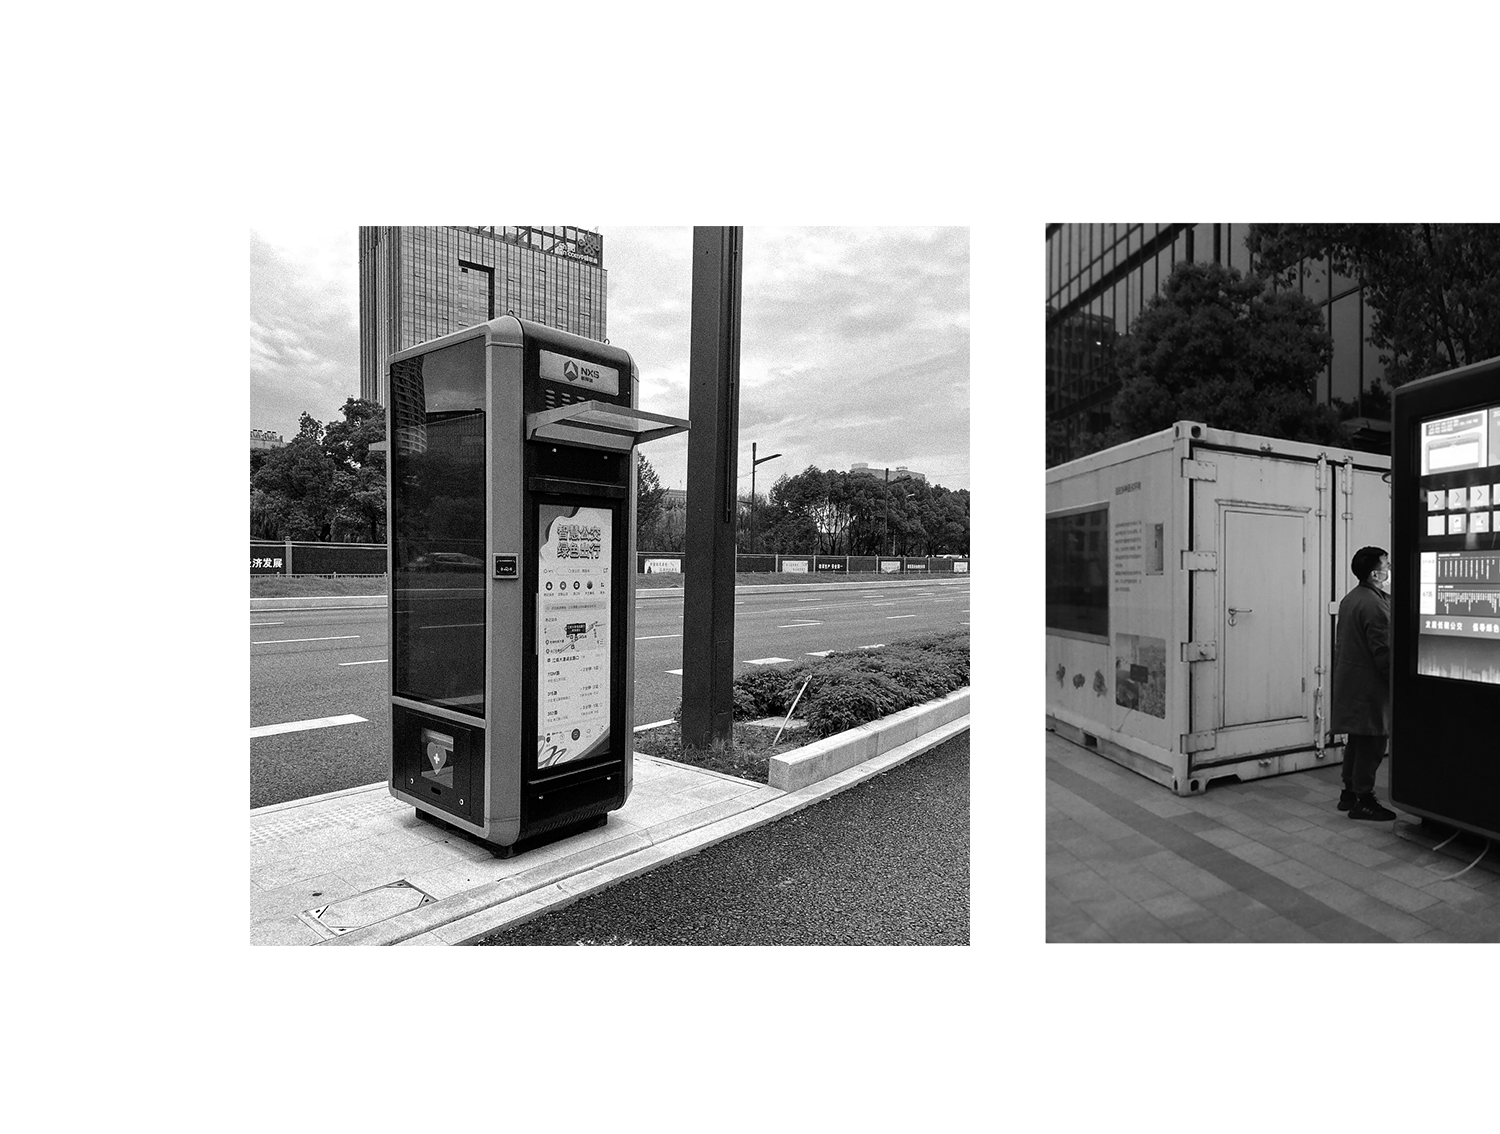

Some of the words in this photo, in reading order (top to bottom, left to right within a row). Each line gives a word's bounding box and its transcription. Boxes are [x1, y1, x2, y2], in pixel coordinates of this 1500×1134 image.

[581, 367, 600, 379] NXS
[557, 524, 601, 542] 智慧公交
[557, 542, 601, 559] 绿色出行
[250, 558, 283, 568] 济发展
